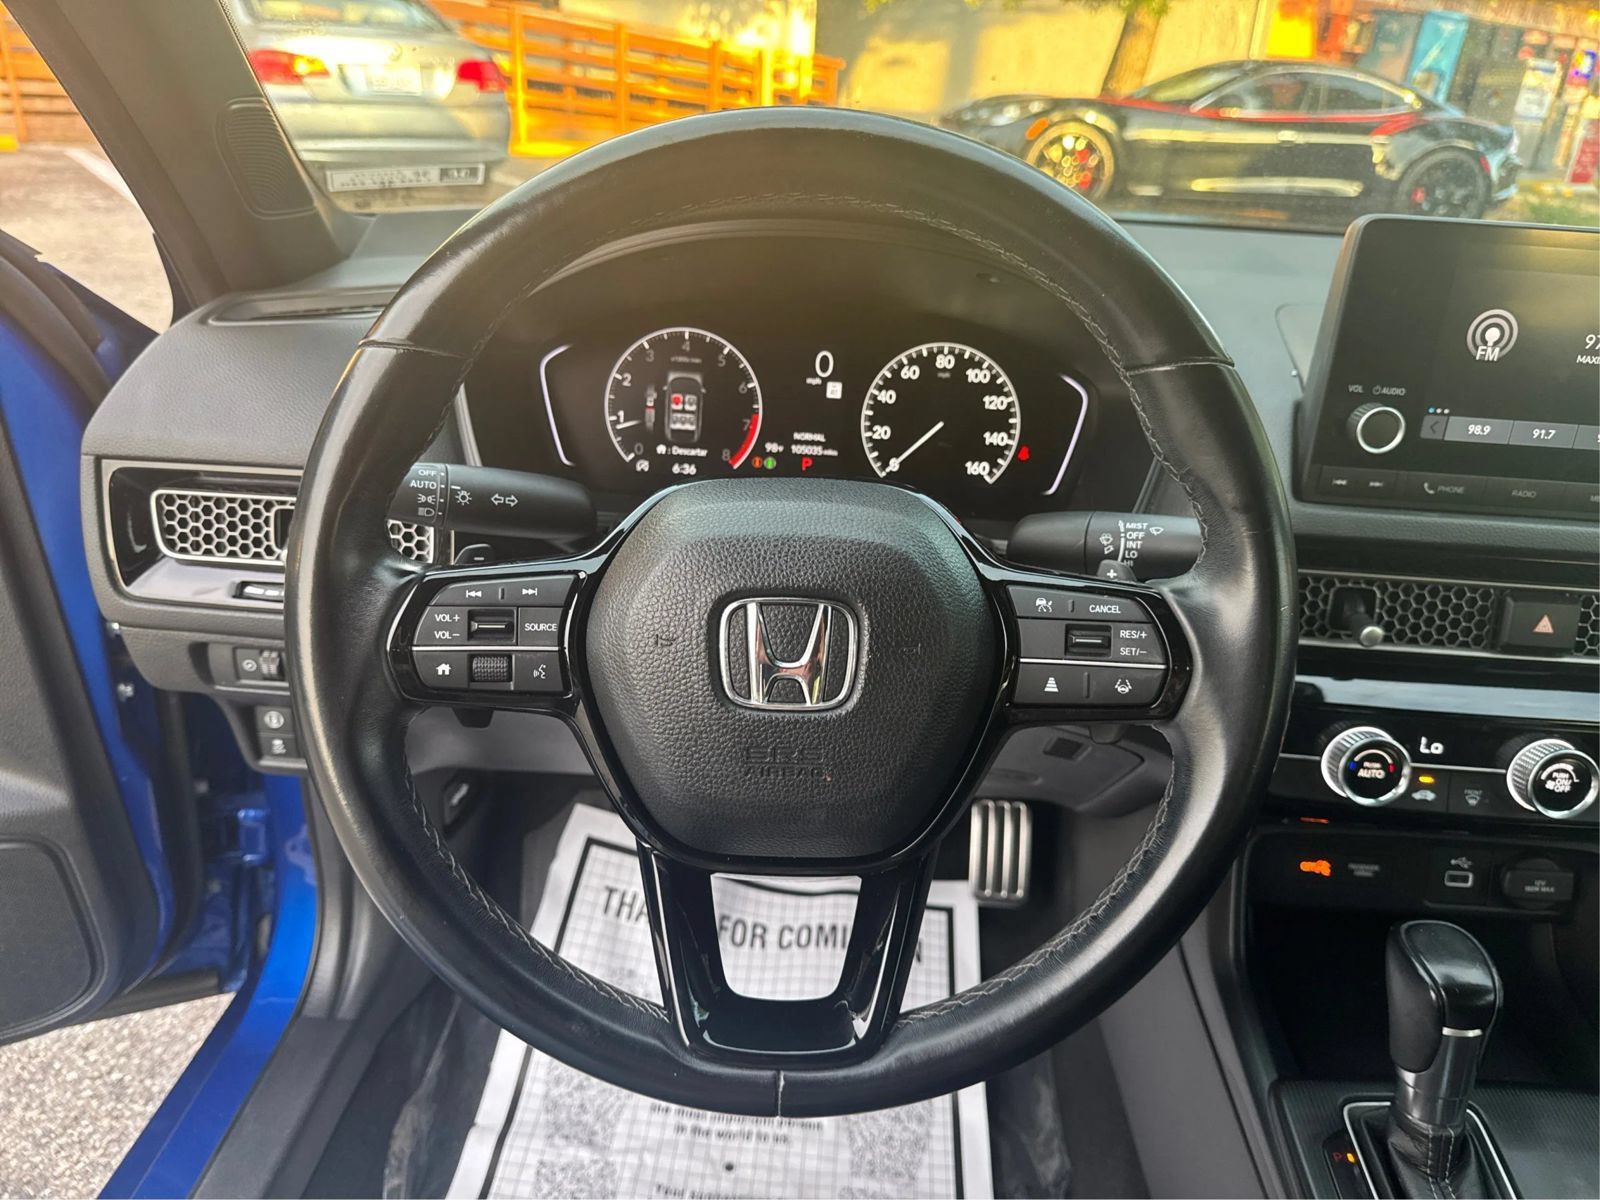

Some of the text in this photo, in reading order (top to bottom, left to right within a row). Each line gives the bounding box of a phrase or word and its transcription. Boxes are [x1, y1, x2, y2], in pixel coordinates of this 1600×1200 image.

[645, 350, 655, 362] 3
[1475, 345, 1500, 362] FM
[717, 355, 727, 367] 5
[815, 350, 835, 378] 0
[935, 354, 955, 369] 80
[900, 366, 920, 380] 60
[965, 368, 991, 384] 100
[622, 373, 632, 387] 2
[738, 382, 748, 394] 6
[1348, 384, 1406, 396] VOL AUDIO
[877, 391, 897, 404] 40
[983, 396, 1007, 411] 120
[872, 425, 891, 439] 20
[1467, 424, 1492, 436] 98.9
[1532, 428, 1556, 441] 91.7
[793, 432, 826, 443] NORMAL
[984, 432, 1008, 446] 140
[634, 443, 644, 456] 0
[722, 449, 731, 462] 8
[672, 462, 697, 475] 6:36
[801, 458, 813, 471] P
[965, 461, 990, 476] 160
[418, 469, 437, 477] OFF
[409, 480, 437, 490] AUTO
[1437, 485, 1465, 495] PHONE
[1511, 489, 1537, 499] RADIO
[1126, 522, 1149, 530] MIST
[1126, 531, 1145, 540] OFF
[1126, 541, 1143, 550] INT
[1125, 550, 1138, 559] LO
[1089, 604, 1121, 614] CANCEL
[524, 622, 558, 632] SOURCE
[1119, 629, 1148, 639] RES/+
[1420, 736, 1444, 755] Lo
[1357, 768, 1386, 779] AUTO
[603, 884, 848, 950] THA FOR COMI
